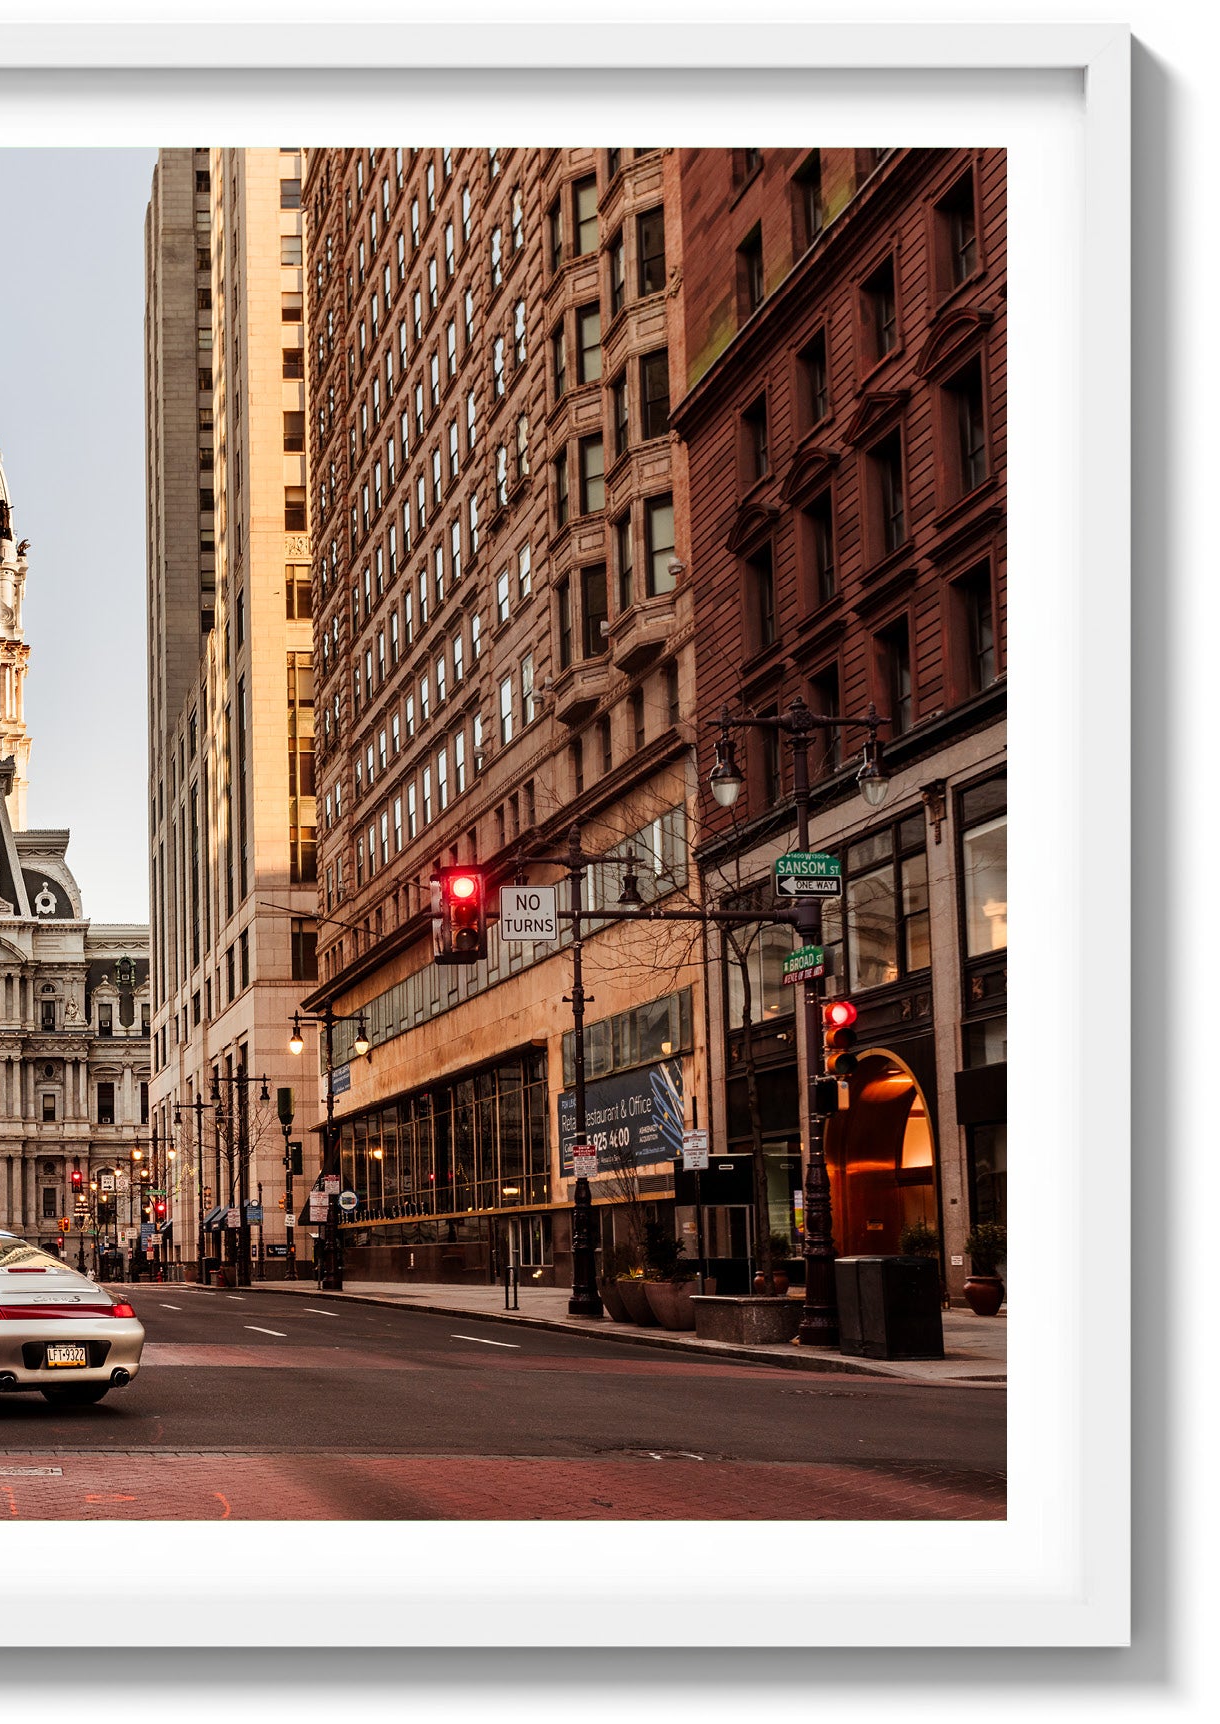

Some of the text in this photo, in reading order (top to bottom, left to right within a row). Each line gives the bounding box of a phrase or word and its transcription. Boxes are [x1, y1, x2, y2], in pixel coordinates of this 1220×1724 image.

[778, 861, 839, 875] SANSOM ST
[796, 880, 834, 890] ONE WAY
[516, 894, 541, 911] NO
[504, 918, 554, 933] TURNS
[790, 953, 814, 972] BROAD
[621, 1099, 627, 1119] &
[629, 1094, 652, 1117] Office
